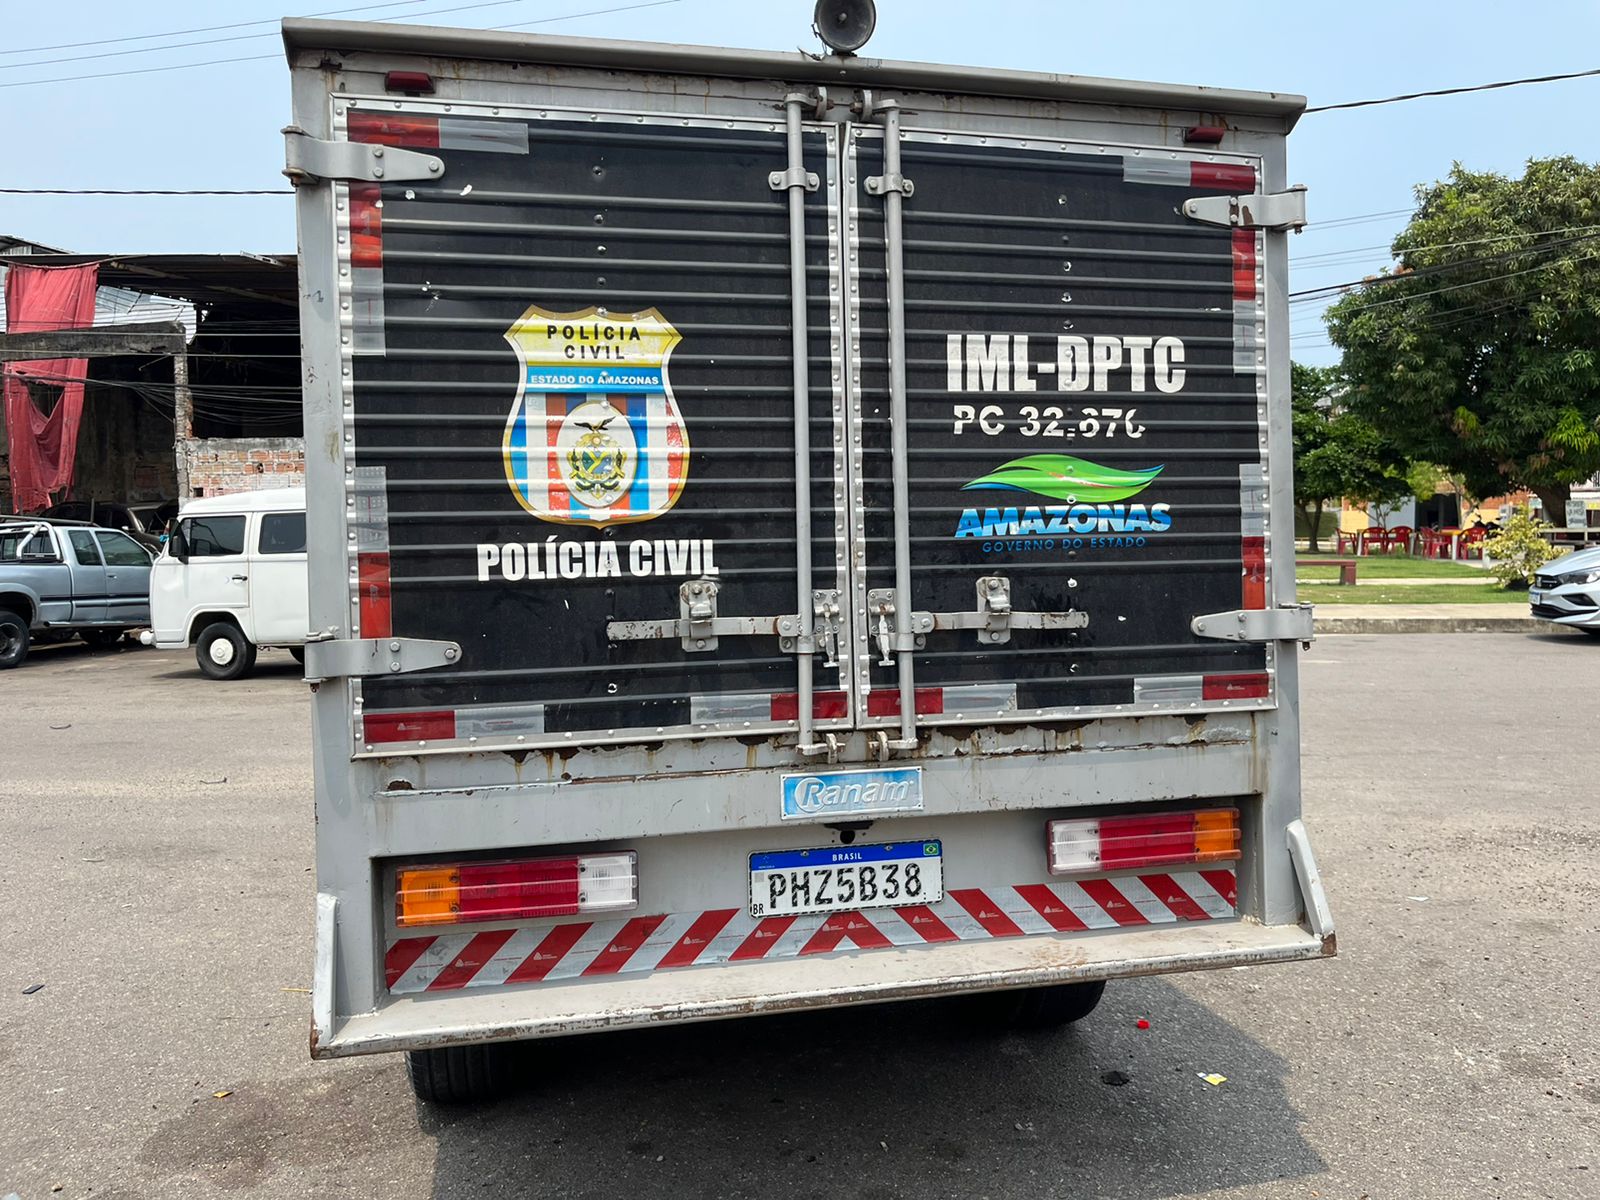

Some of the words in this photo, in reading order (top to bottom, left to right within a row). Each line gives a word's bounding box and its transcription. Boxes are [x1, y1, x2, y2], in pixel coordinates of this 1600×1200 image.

[547, 323, 641, 341] POLÍCIA
[564, 345, 625, 360] CIVIL
[947, 334, 1187, 393] IML-DPTC
[531, 375, 575, 384] ESTADO
[579, 375, 595, 384] DO
[598, 376, 659, 385] AMAZONAS
[953, 405, 1005, 435] PC
[954, 503, 1172, 538] AMAZONAS
[982, 539, 1055, 553] GOVERNO
[1062, 538, 1083, 549] DO
[1090, 536, 1146, 548] ESTADO
[476, 535, 622, 581] POLÍCIA
[629, 539, 719, 576] CIVIL
[801, 780, 910, 807] Ranam
[832, 854, 863, 862] BRASIL
[767, 863, 922, 909] PHZ5B38
[753, 903, 764, 914] BR
